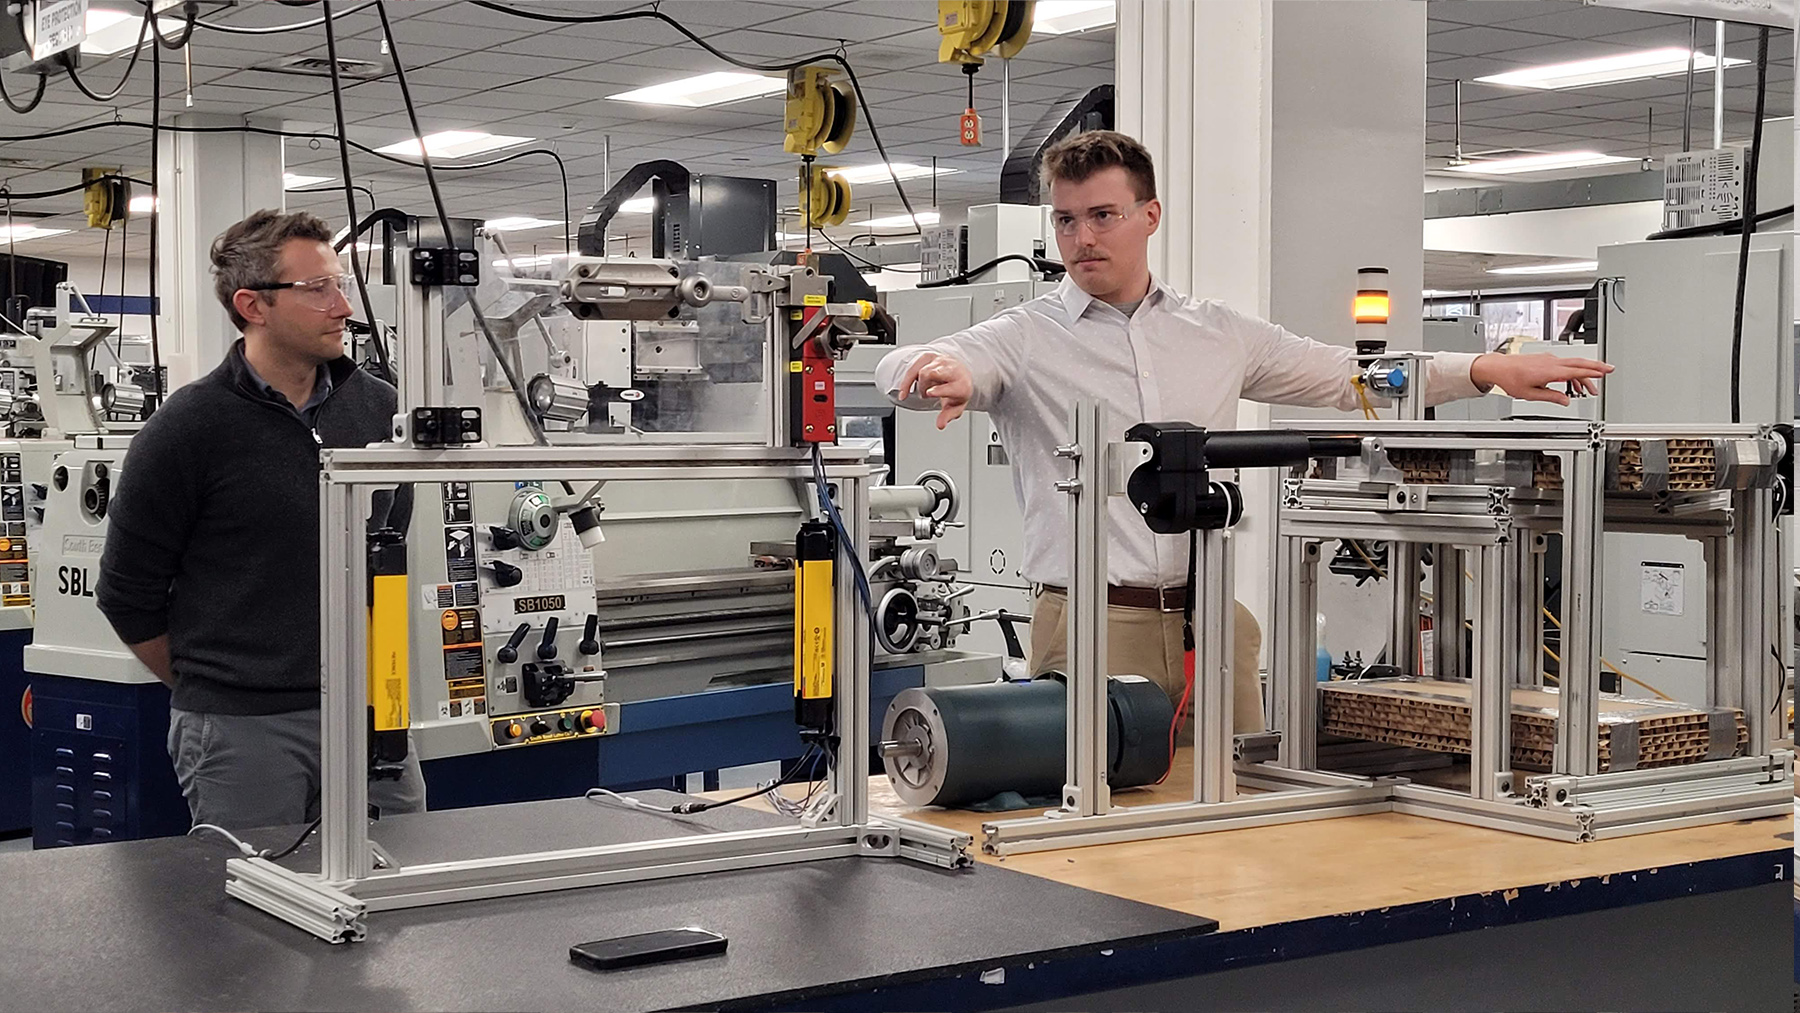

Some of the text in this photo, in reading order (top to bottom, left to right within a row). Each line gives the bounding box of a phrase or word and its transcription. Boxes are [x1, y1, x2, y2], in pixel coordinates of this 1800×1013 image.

[41, 1, 82, 31] EYE PROTECTION
[58, 565, 94, 597] SBL
[518, 596, 562, 612] SB1050
